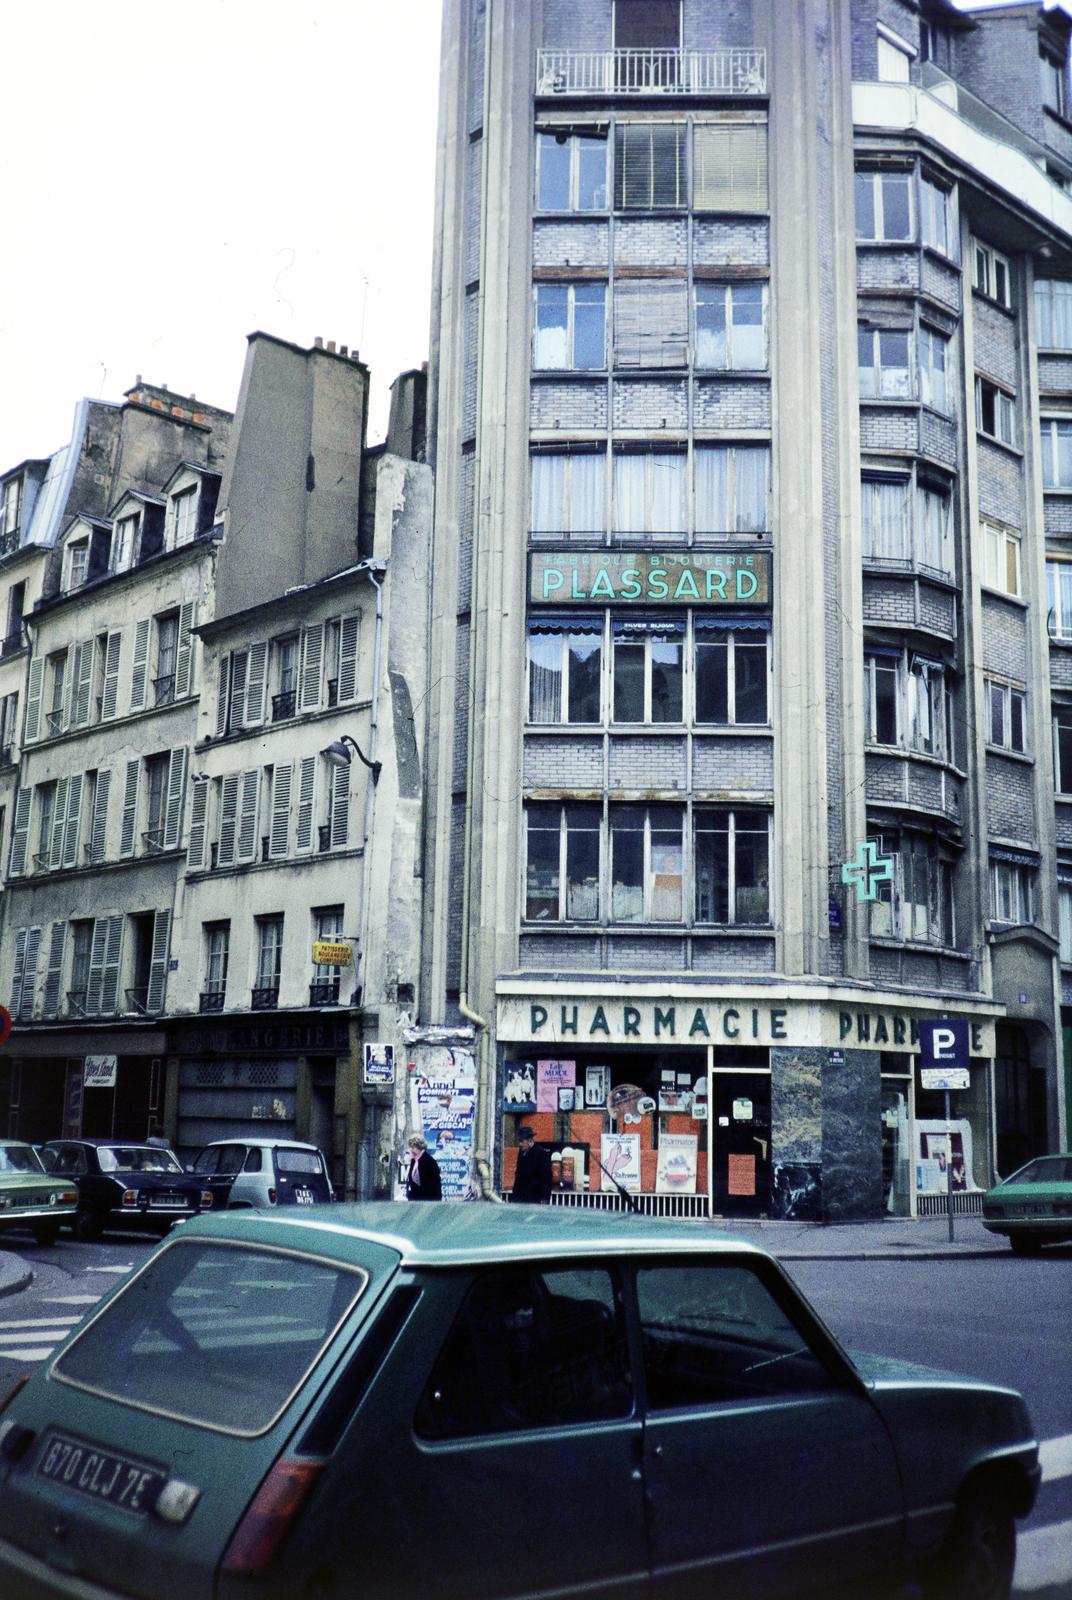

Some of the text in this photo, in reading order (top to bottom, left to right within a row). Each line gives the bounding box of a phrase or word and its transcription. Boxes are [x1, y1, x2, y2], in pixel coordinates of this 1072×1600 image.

[544, 555, 755, 567] FABRIQUE BIJOUTERIE
[542, 568, 759, 600] PLASSARD
[530, 1004, 788, 1038] PHARMACIE
[932, 1028, 956, 1059] P
[419, 1088, 460, 1097] DOMINATI
[78, 1453, 123, 1498] CLJ
